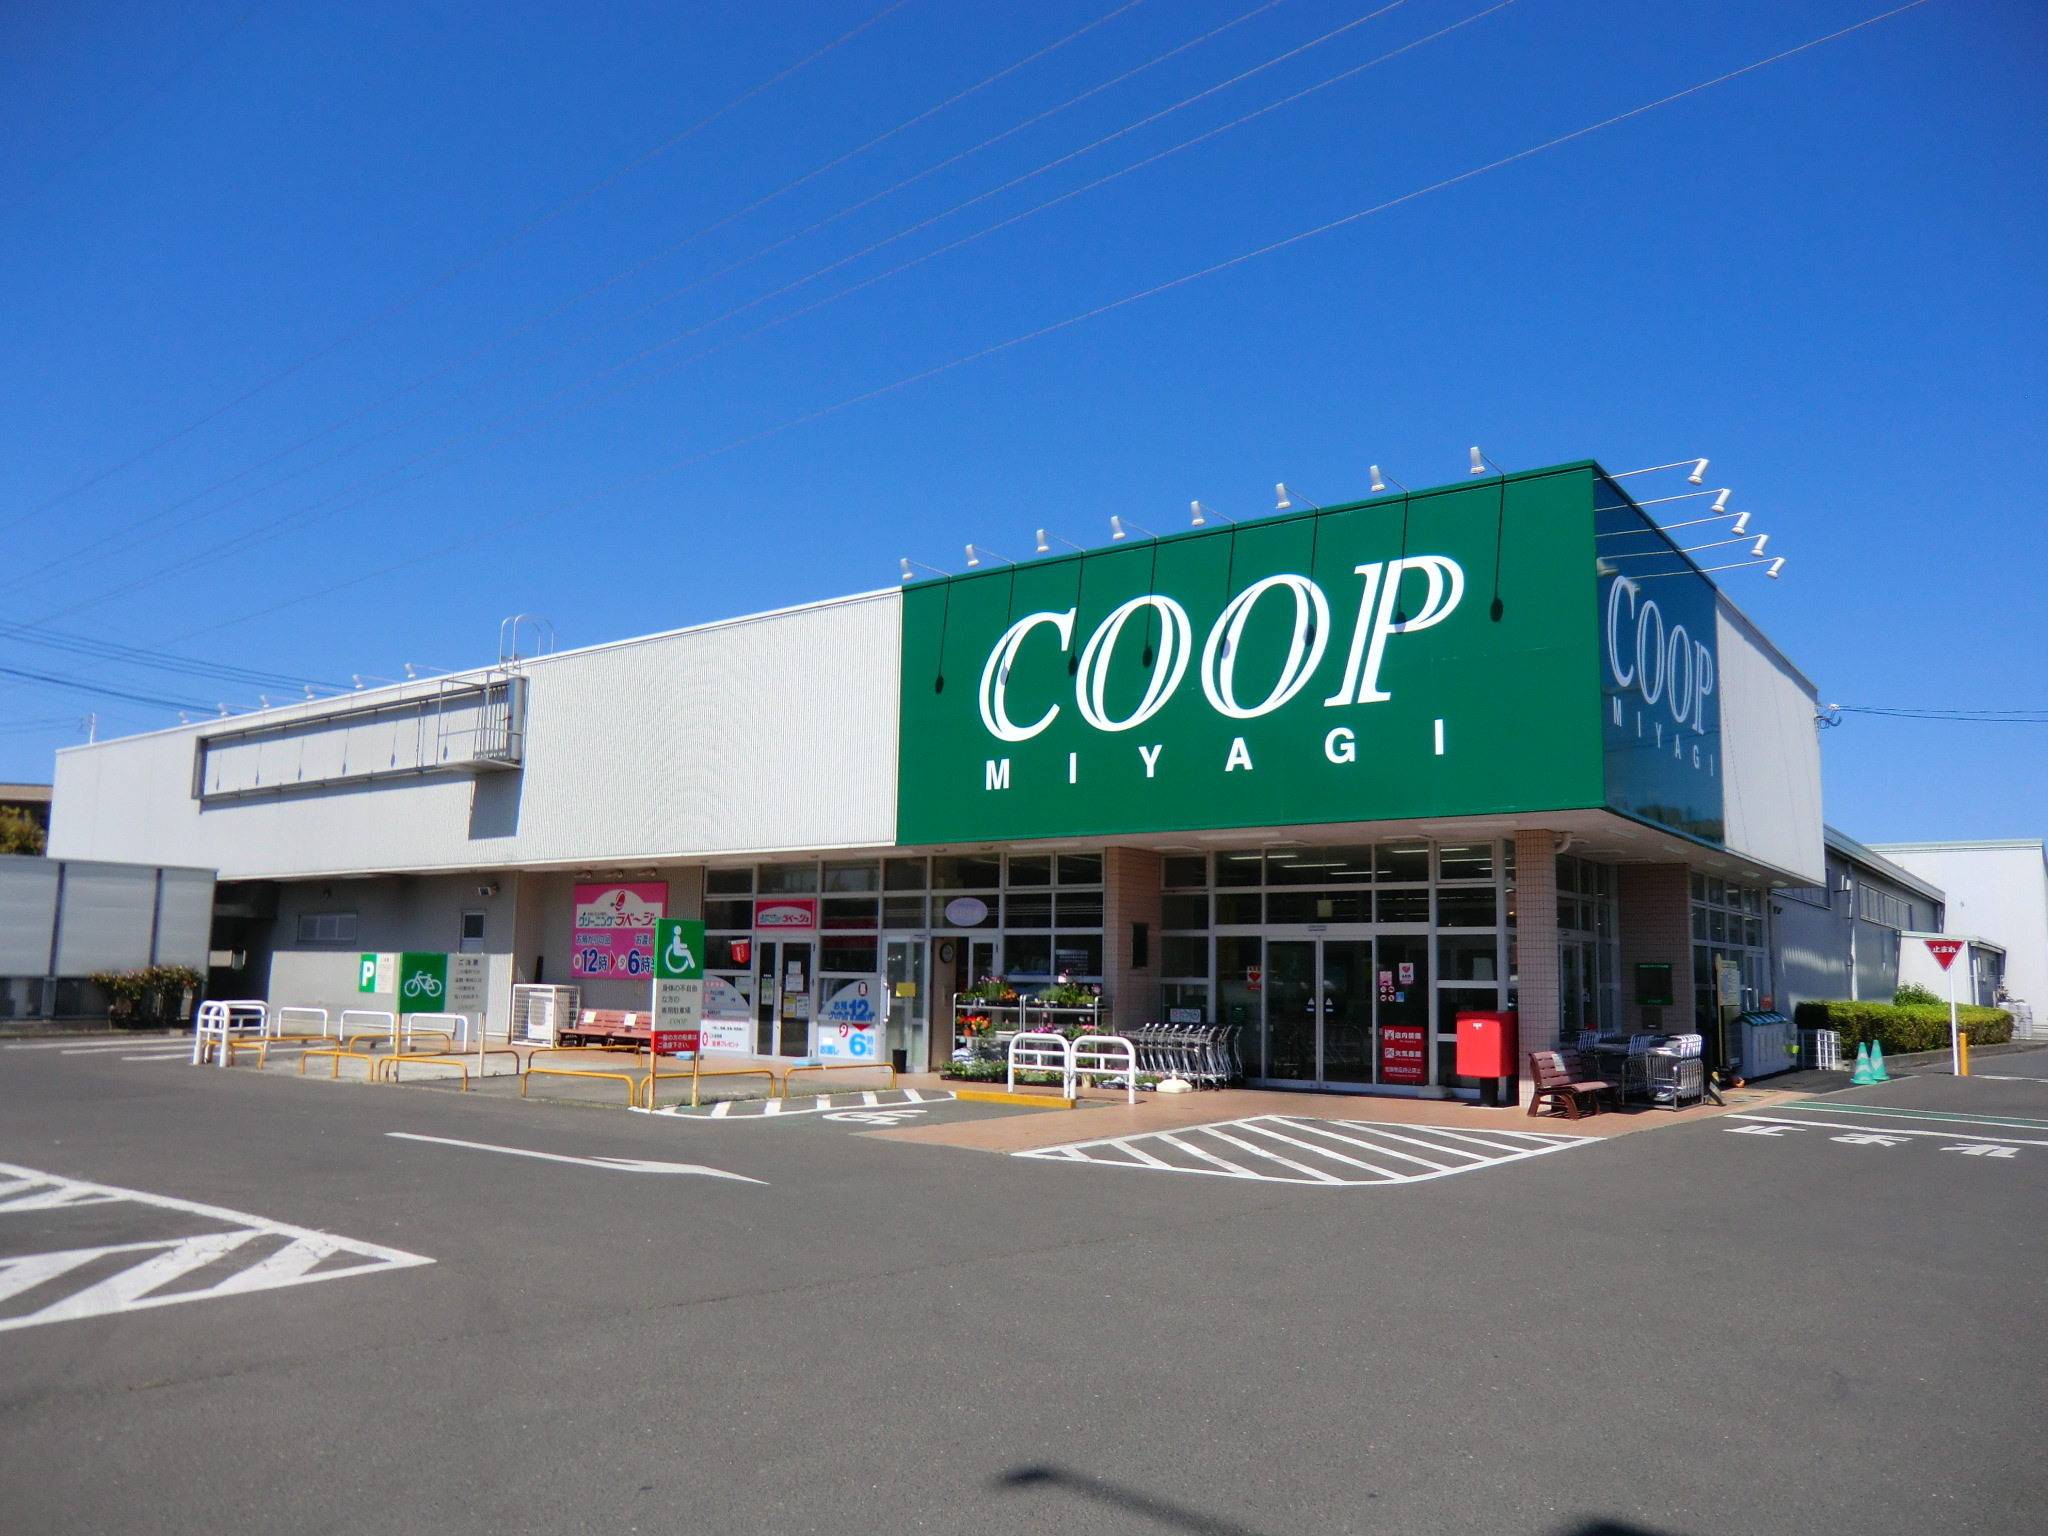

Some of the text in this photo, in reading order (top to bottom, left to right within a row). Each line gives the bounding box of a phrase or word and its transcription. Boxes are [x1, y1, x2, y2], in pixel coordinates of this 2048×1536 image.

[979, 555, 1465, 742] COOP
[1607, 575, 1713, 735] COOP
[985, 718, 1445, 791] MIYAGI
[1613, 695, 1714, 777] MIYAGI
[1933, 945, 1957, 953] 止まれ
[362, 961, 375, 987] P
[662, 984, 698, 993] 身体の不自由
[662, 995, 680, 1003] な方の
